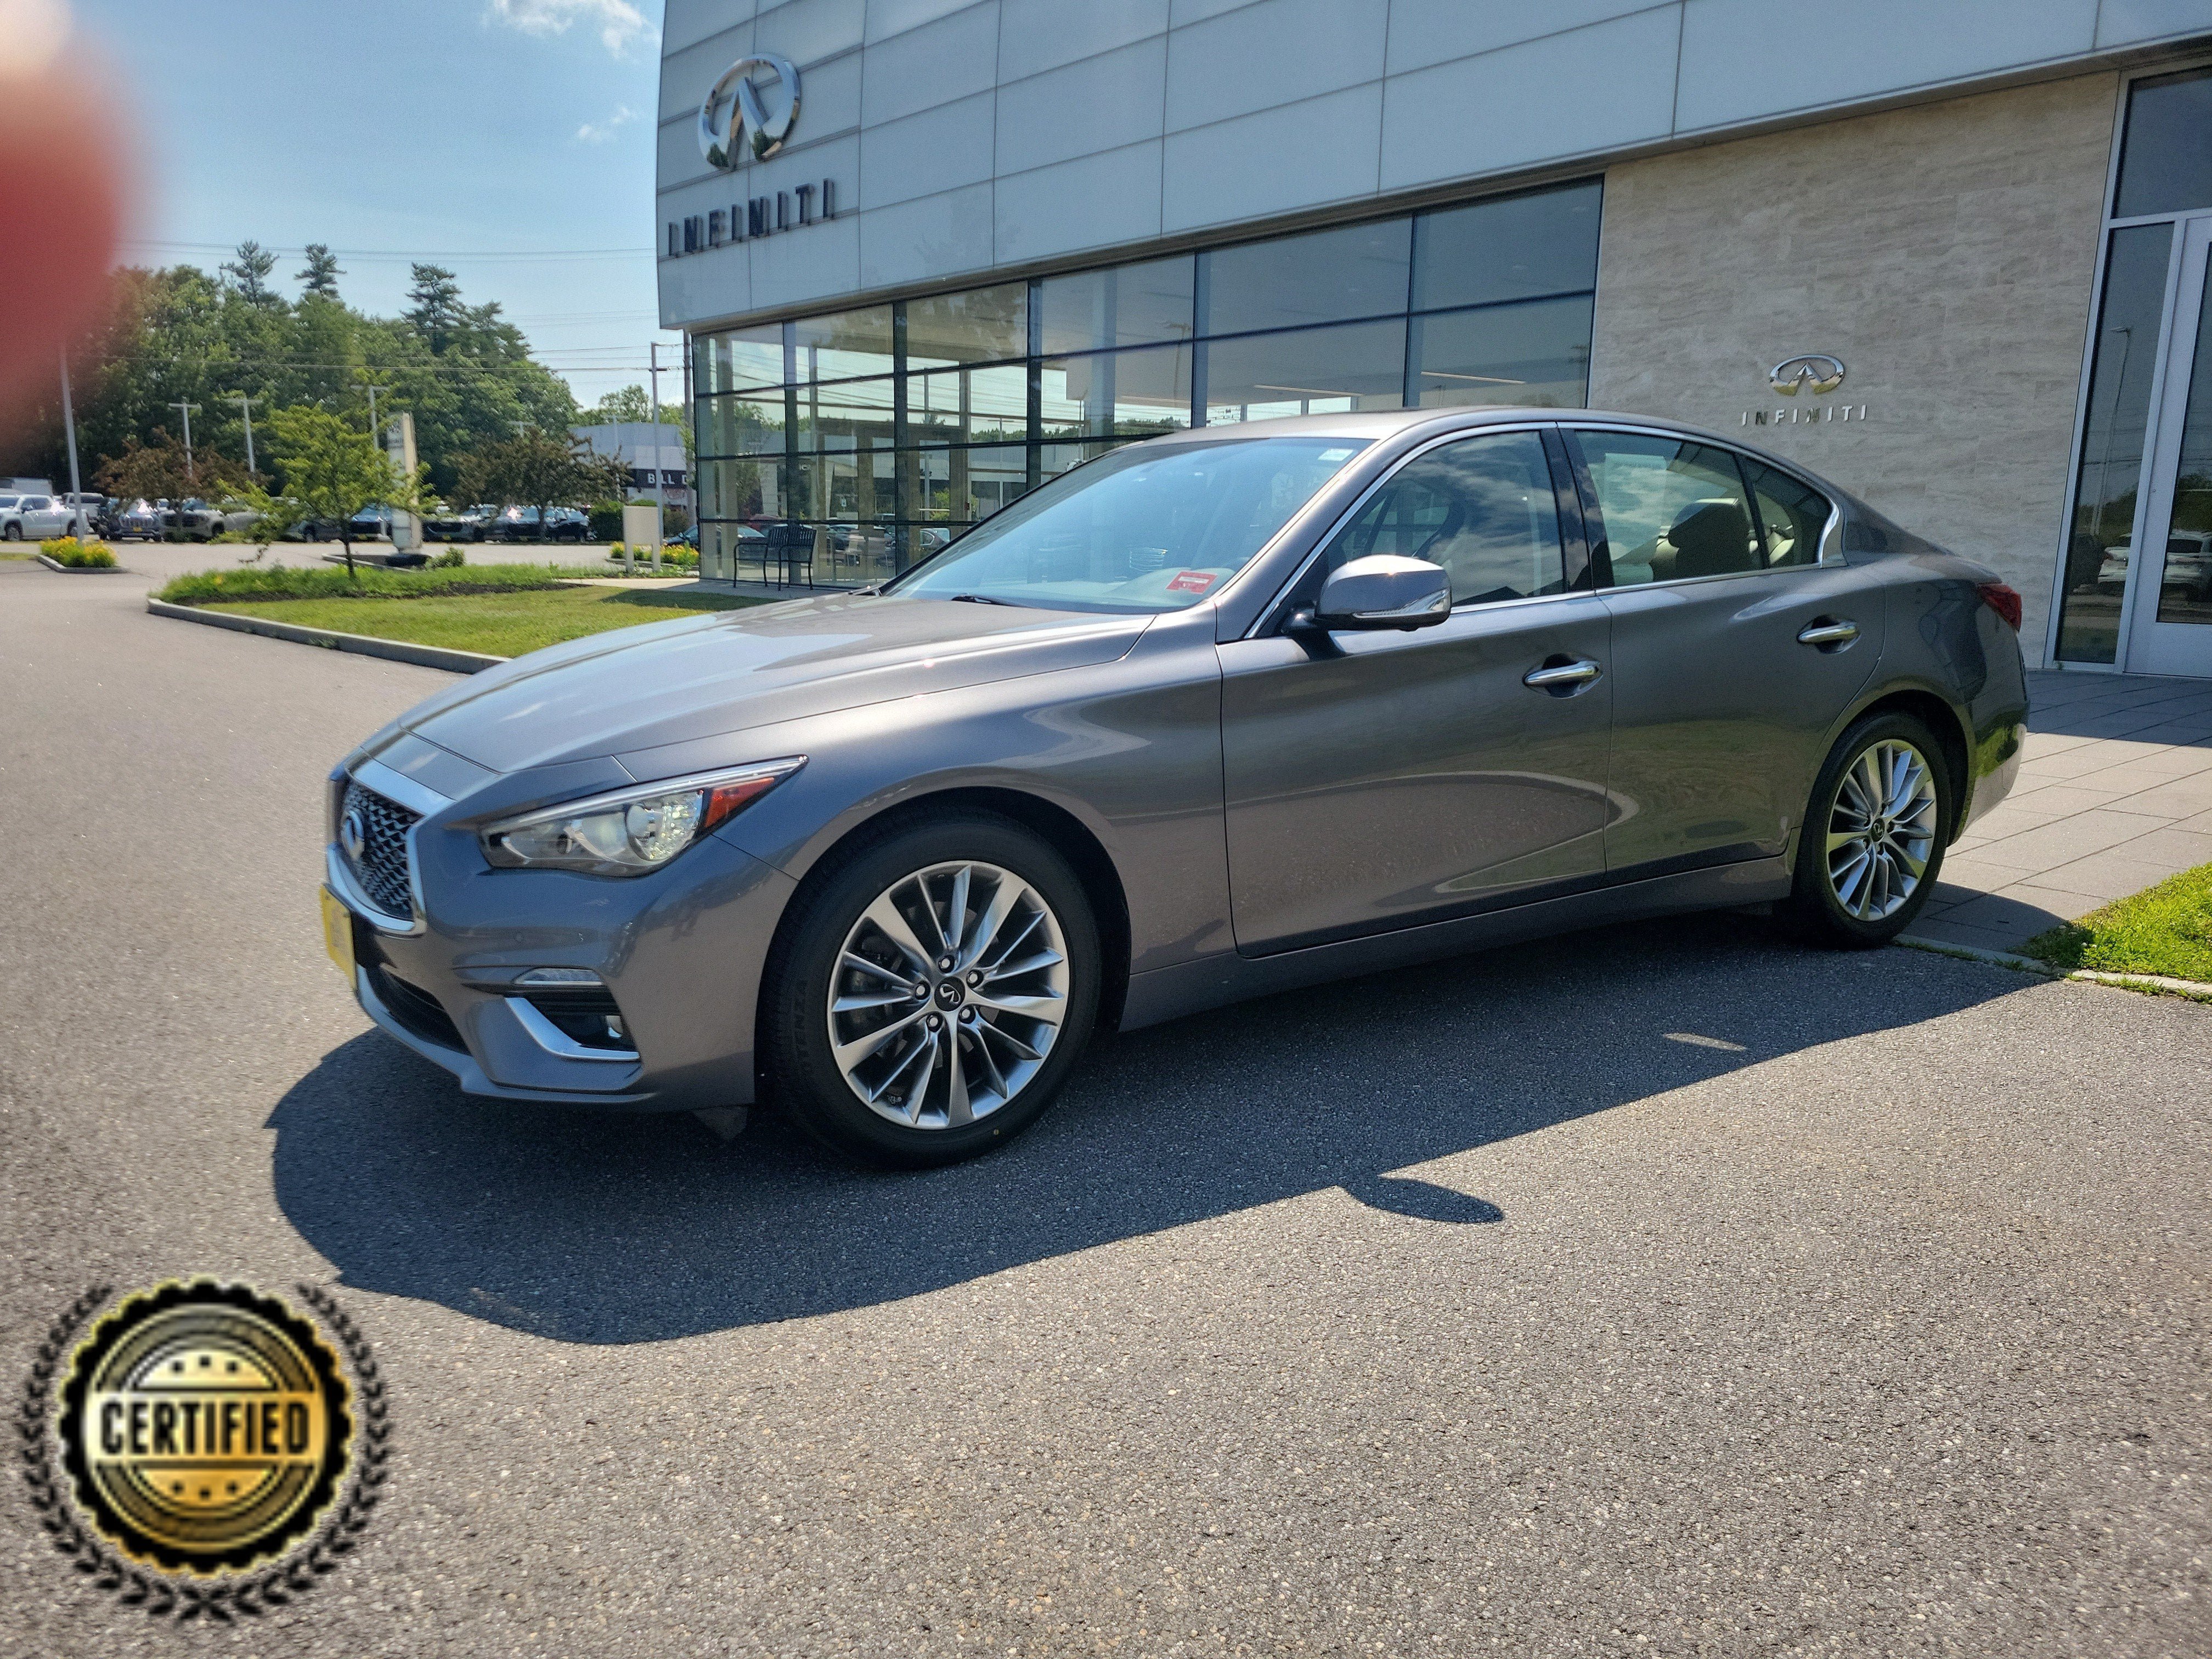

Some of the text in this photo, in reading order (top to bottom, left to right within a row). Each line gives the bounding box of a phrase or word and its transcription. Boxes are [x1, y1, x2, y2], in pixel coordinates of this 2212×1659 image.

[668, 178, 834, 257] INFINITI
[1742, 405, 1867, 426] INFINITI
[648, 473, 675, 484] BLL
